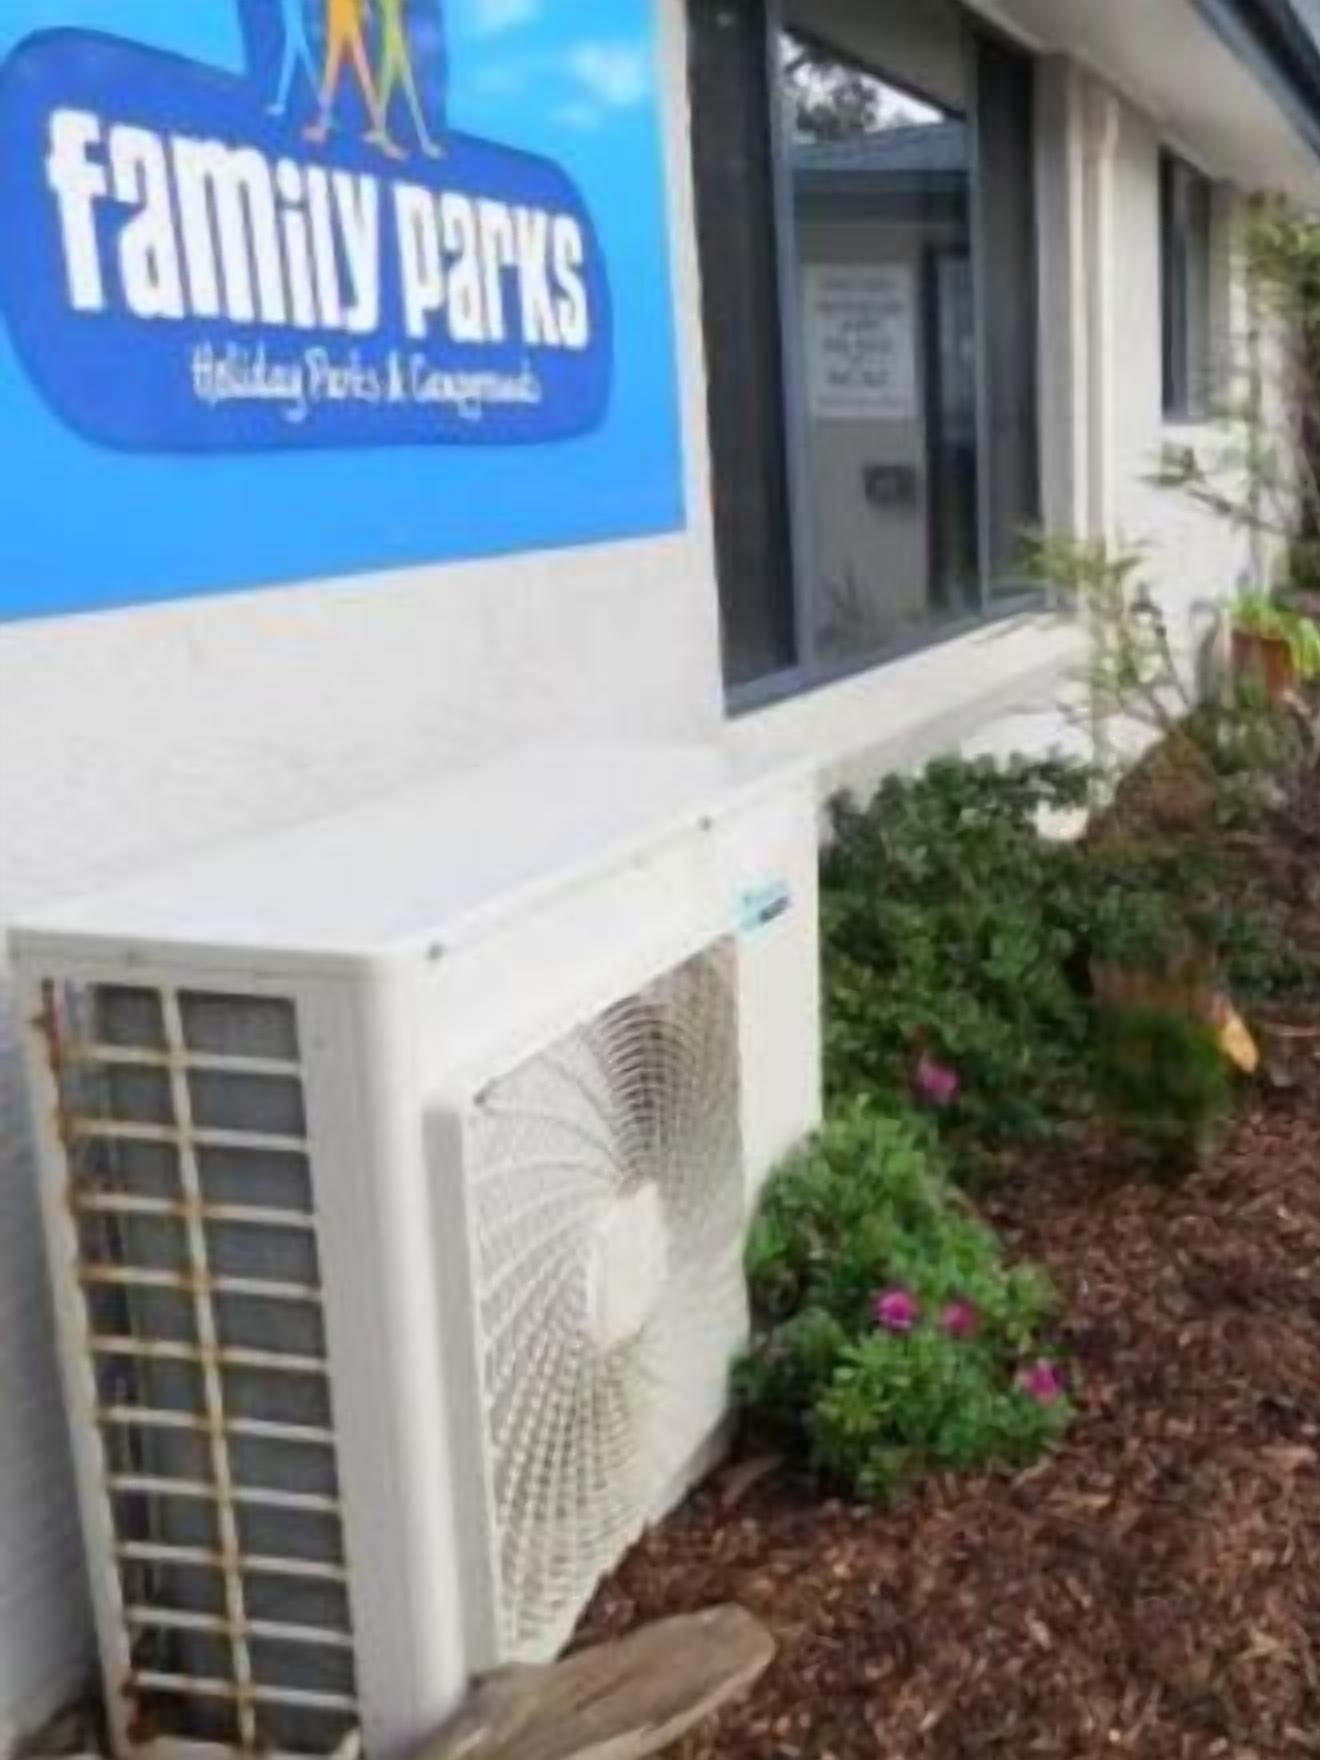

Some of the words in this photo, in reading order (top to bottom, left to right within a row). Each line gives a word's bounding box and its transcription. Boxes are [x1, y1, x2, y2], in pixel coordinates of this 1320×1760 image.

[192, 338, 308, 424] Holiday
[305, 345, 381, 405] Parks
[409, 351, 543, 421] Campgds
